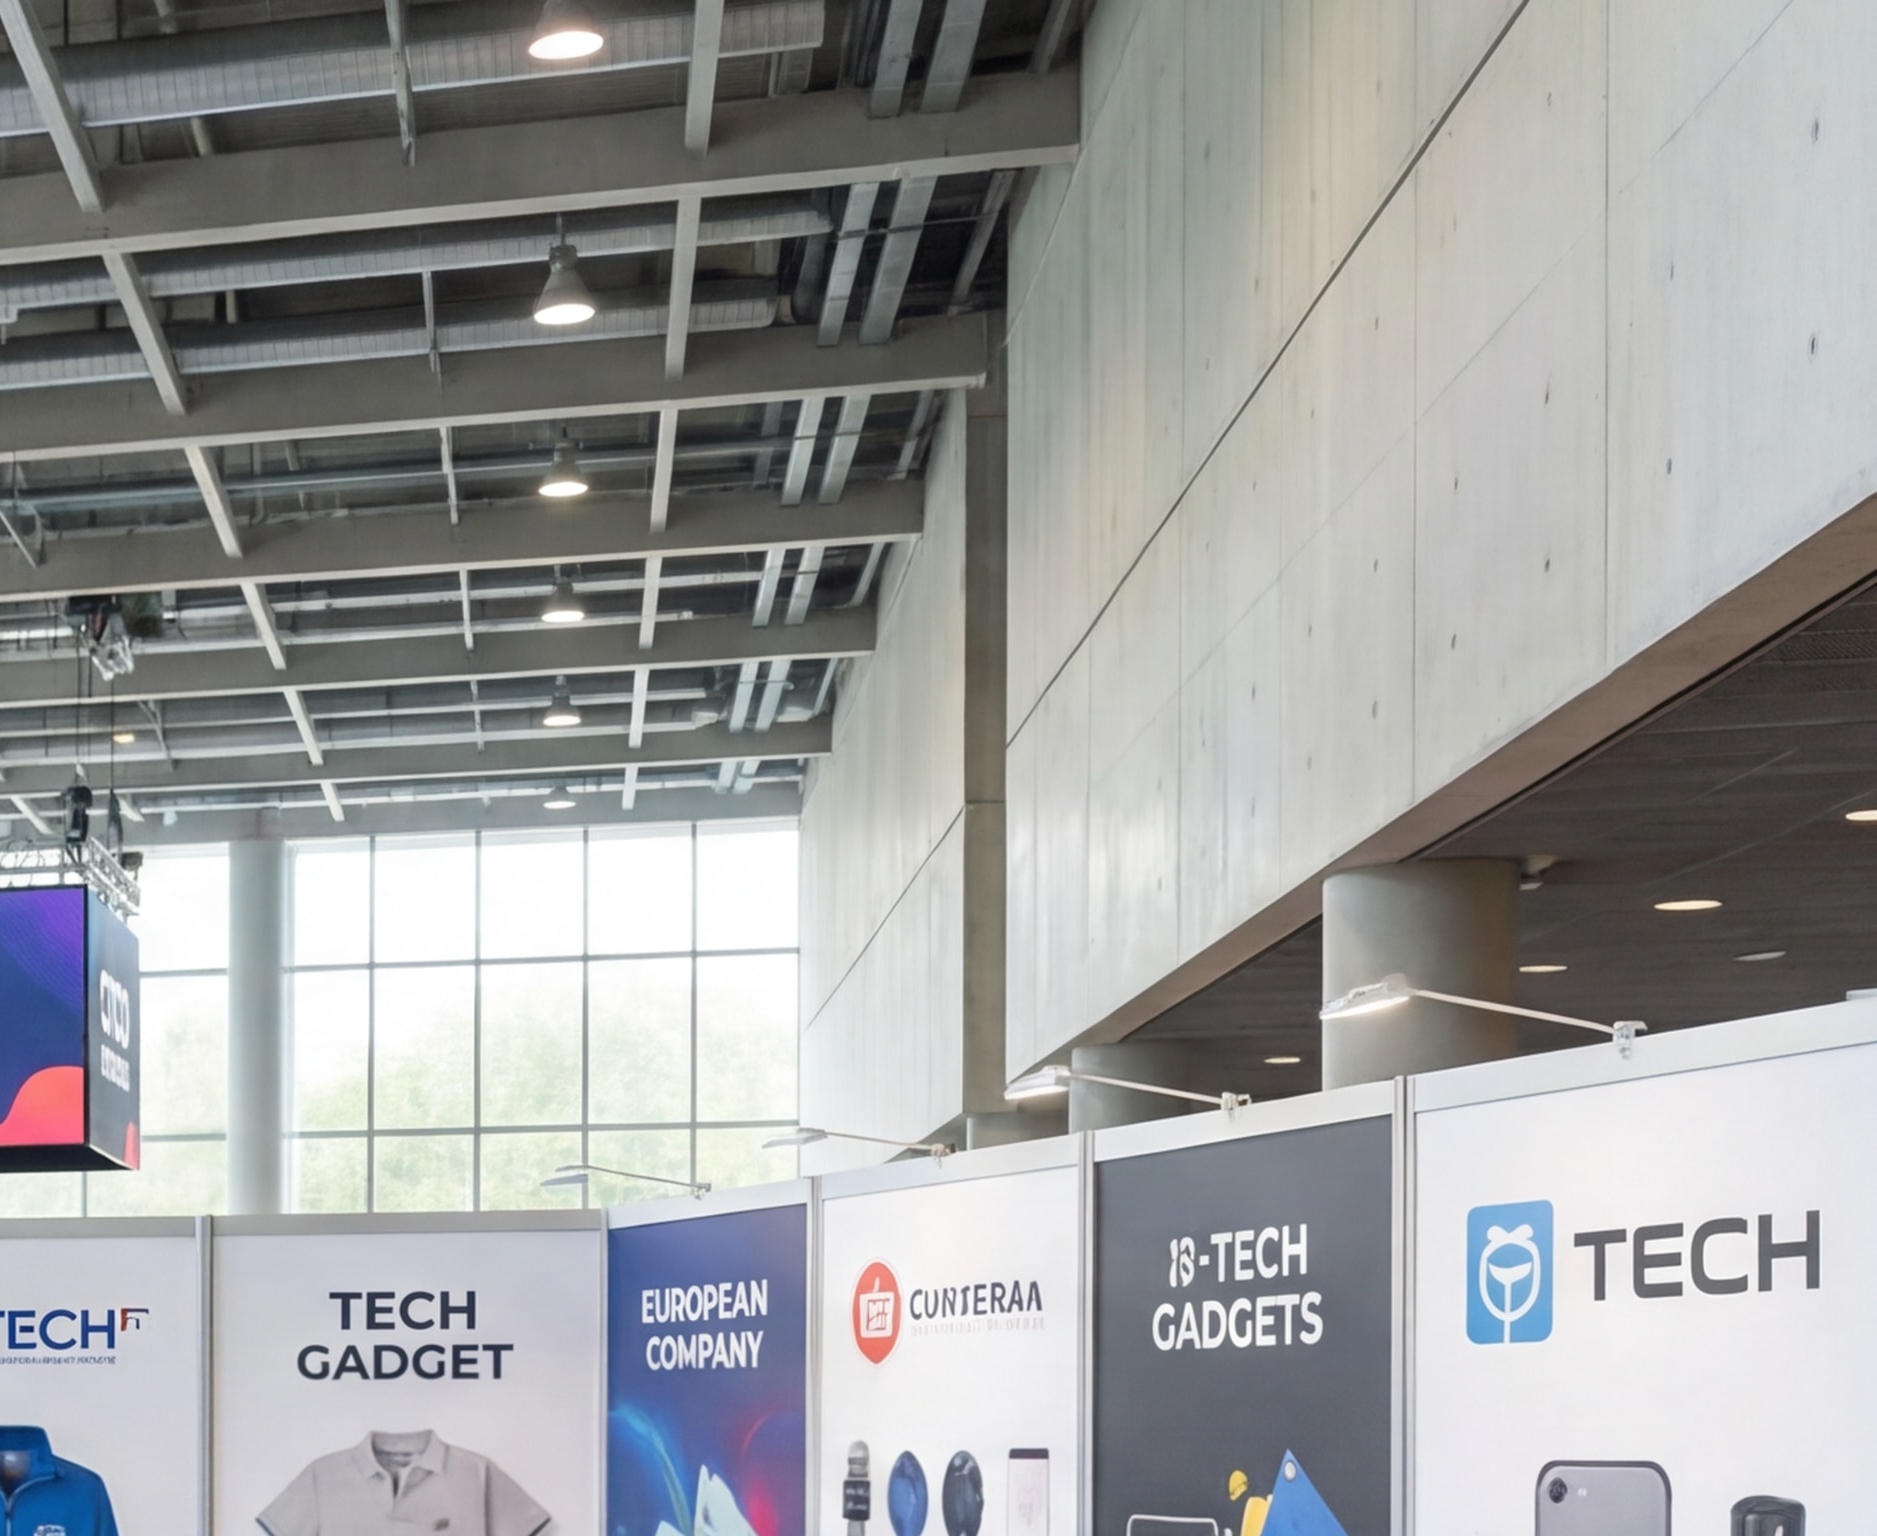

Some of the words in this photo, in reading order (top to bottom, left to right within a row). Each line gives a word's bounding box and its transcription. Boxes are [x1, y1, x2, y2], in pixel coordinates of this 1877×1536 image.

[1574, 1210, 1822, 1302] TECH
[329, 1290, 477, 1331] TECH
[641, 1279, 768, 1324] EUROPEAN
[1152, 1291, 1323, 1351] GADGETS
[296, 1343, 514, 1382] GADGET
[646, 1331, 764, 1371] COMPANY
